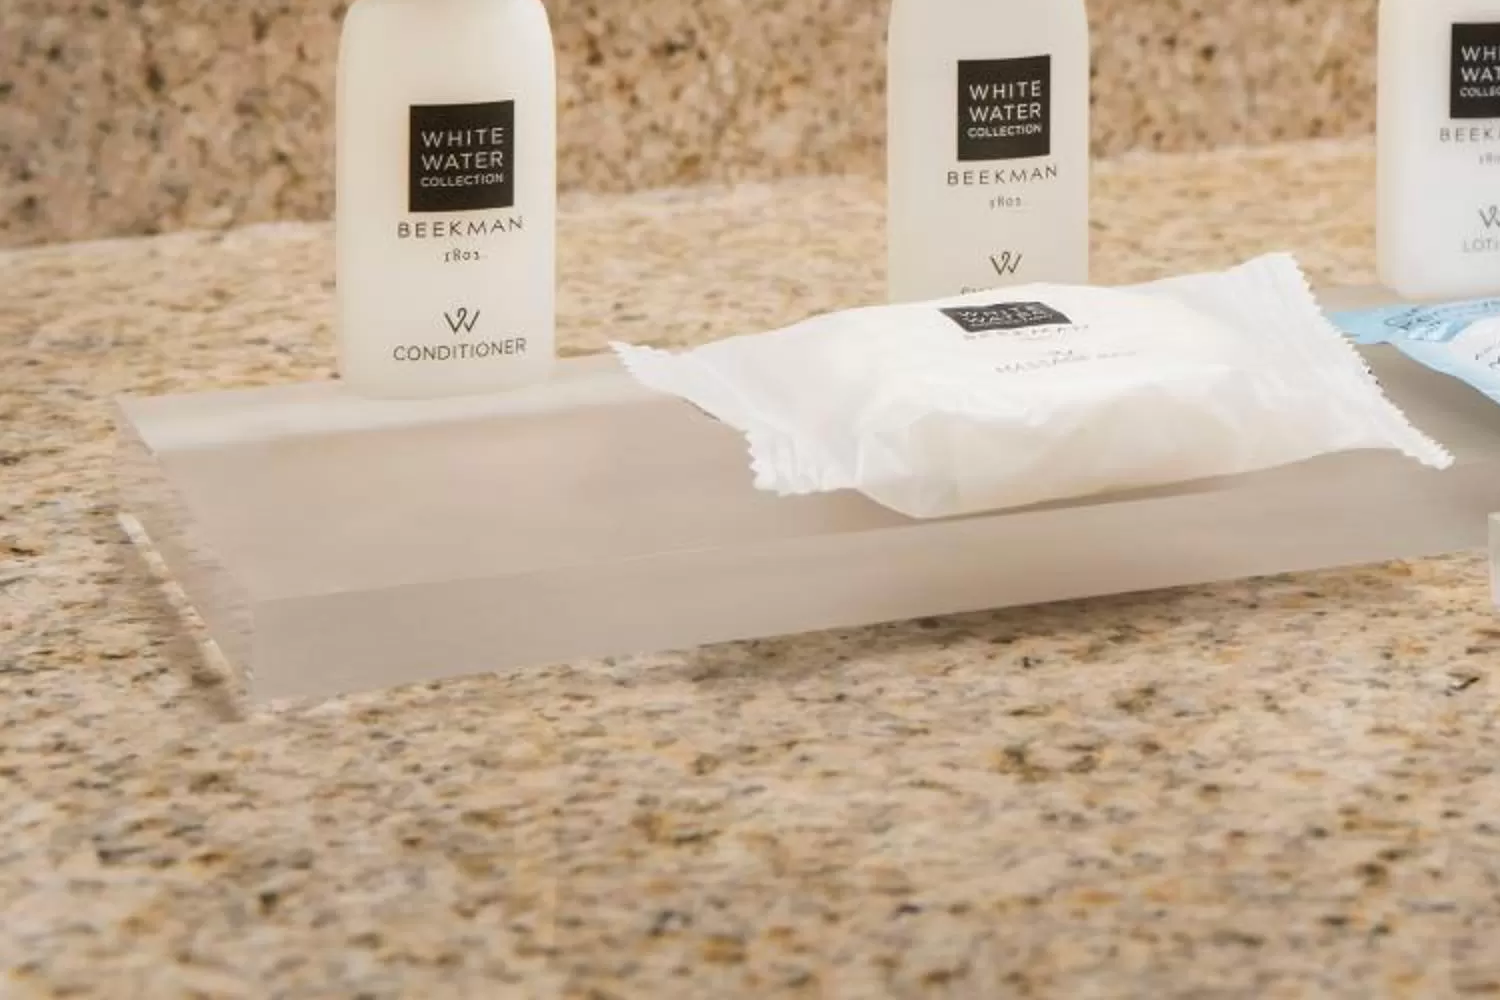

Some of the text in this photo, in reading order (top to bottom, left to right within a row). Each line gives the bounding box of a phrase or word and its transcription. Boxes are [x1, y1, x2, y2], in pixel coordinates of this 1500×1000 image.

[968, 79, 1042, 101] WHITE
[968, 101, 1042, 123] WATER
[420, 126, 505, 149] WHITE
[966, 123, 1043, 139] COLLECTION
[420, 150, 505, 171] WATER
[419, 172, 505, 188] COLLECTION
[946, 164, 1058, 186] BEEKMAN
[396, 215, 525, 239] BEEKMAN
[392, 337, 528, 362] CONDITIONER
